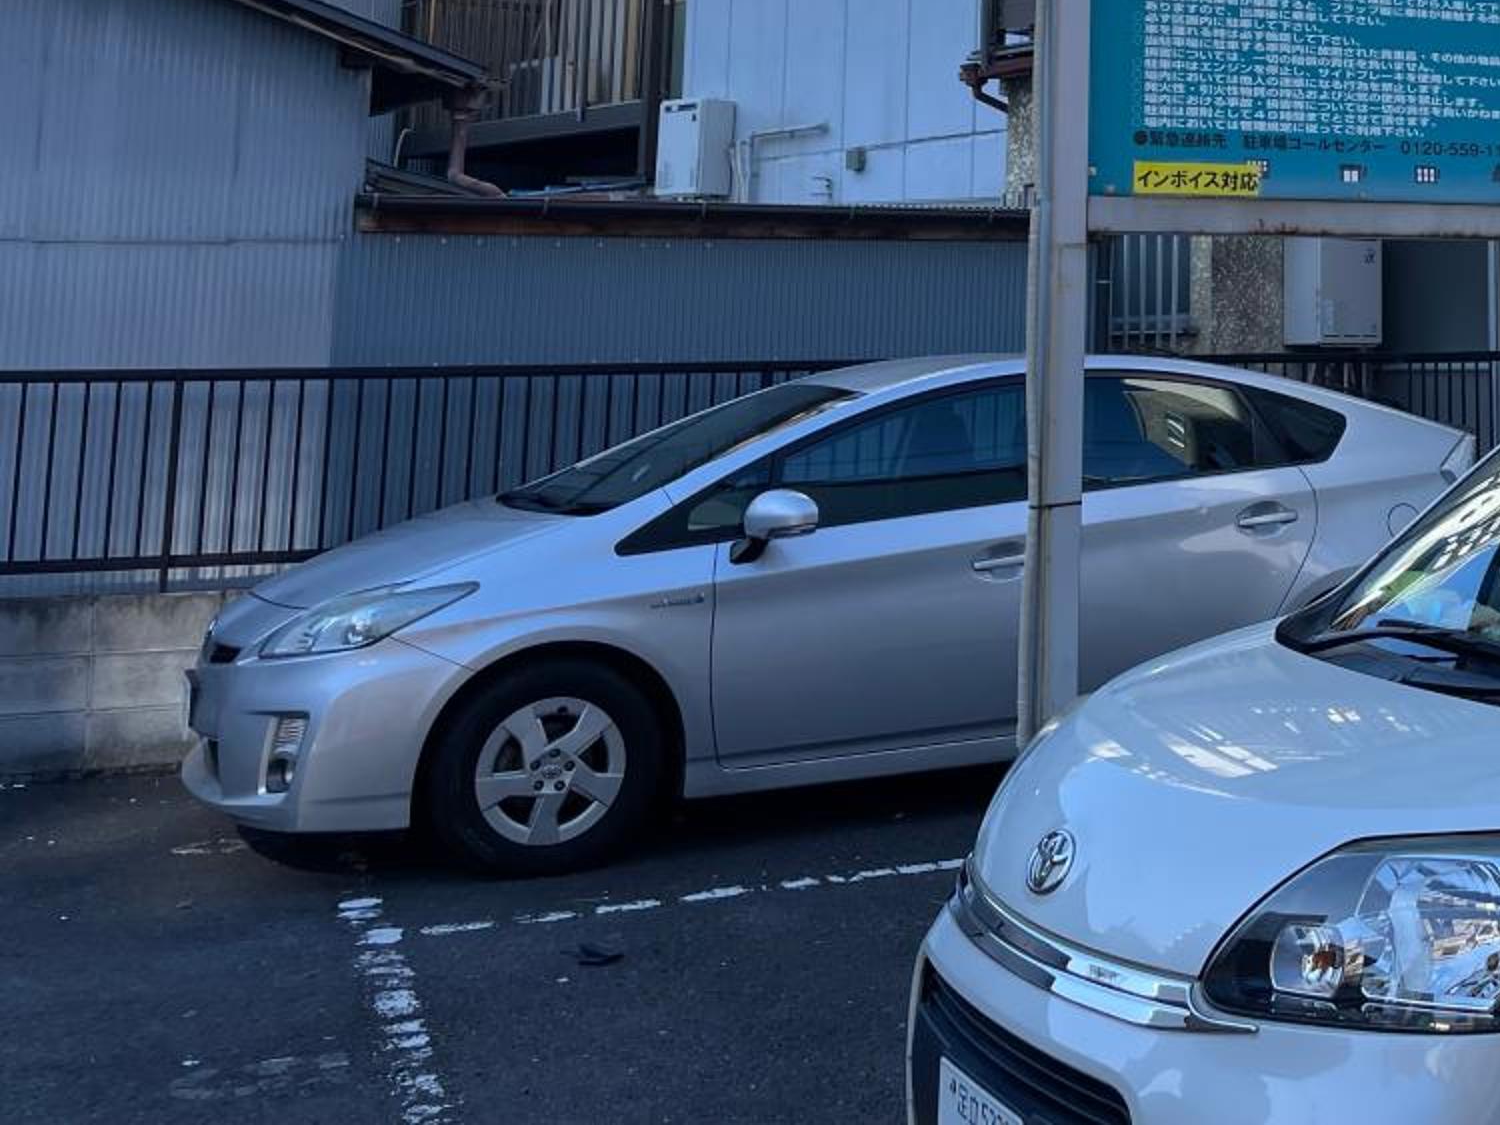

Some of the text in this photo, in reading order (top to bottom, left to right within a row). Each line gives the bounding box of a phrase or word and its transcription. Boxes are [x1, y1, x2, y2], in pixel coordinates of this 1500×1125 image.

[1137, 169, 1259, 192] インボイス対応
